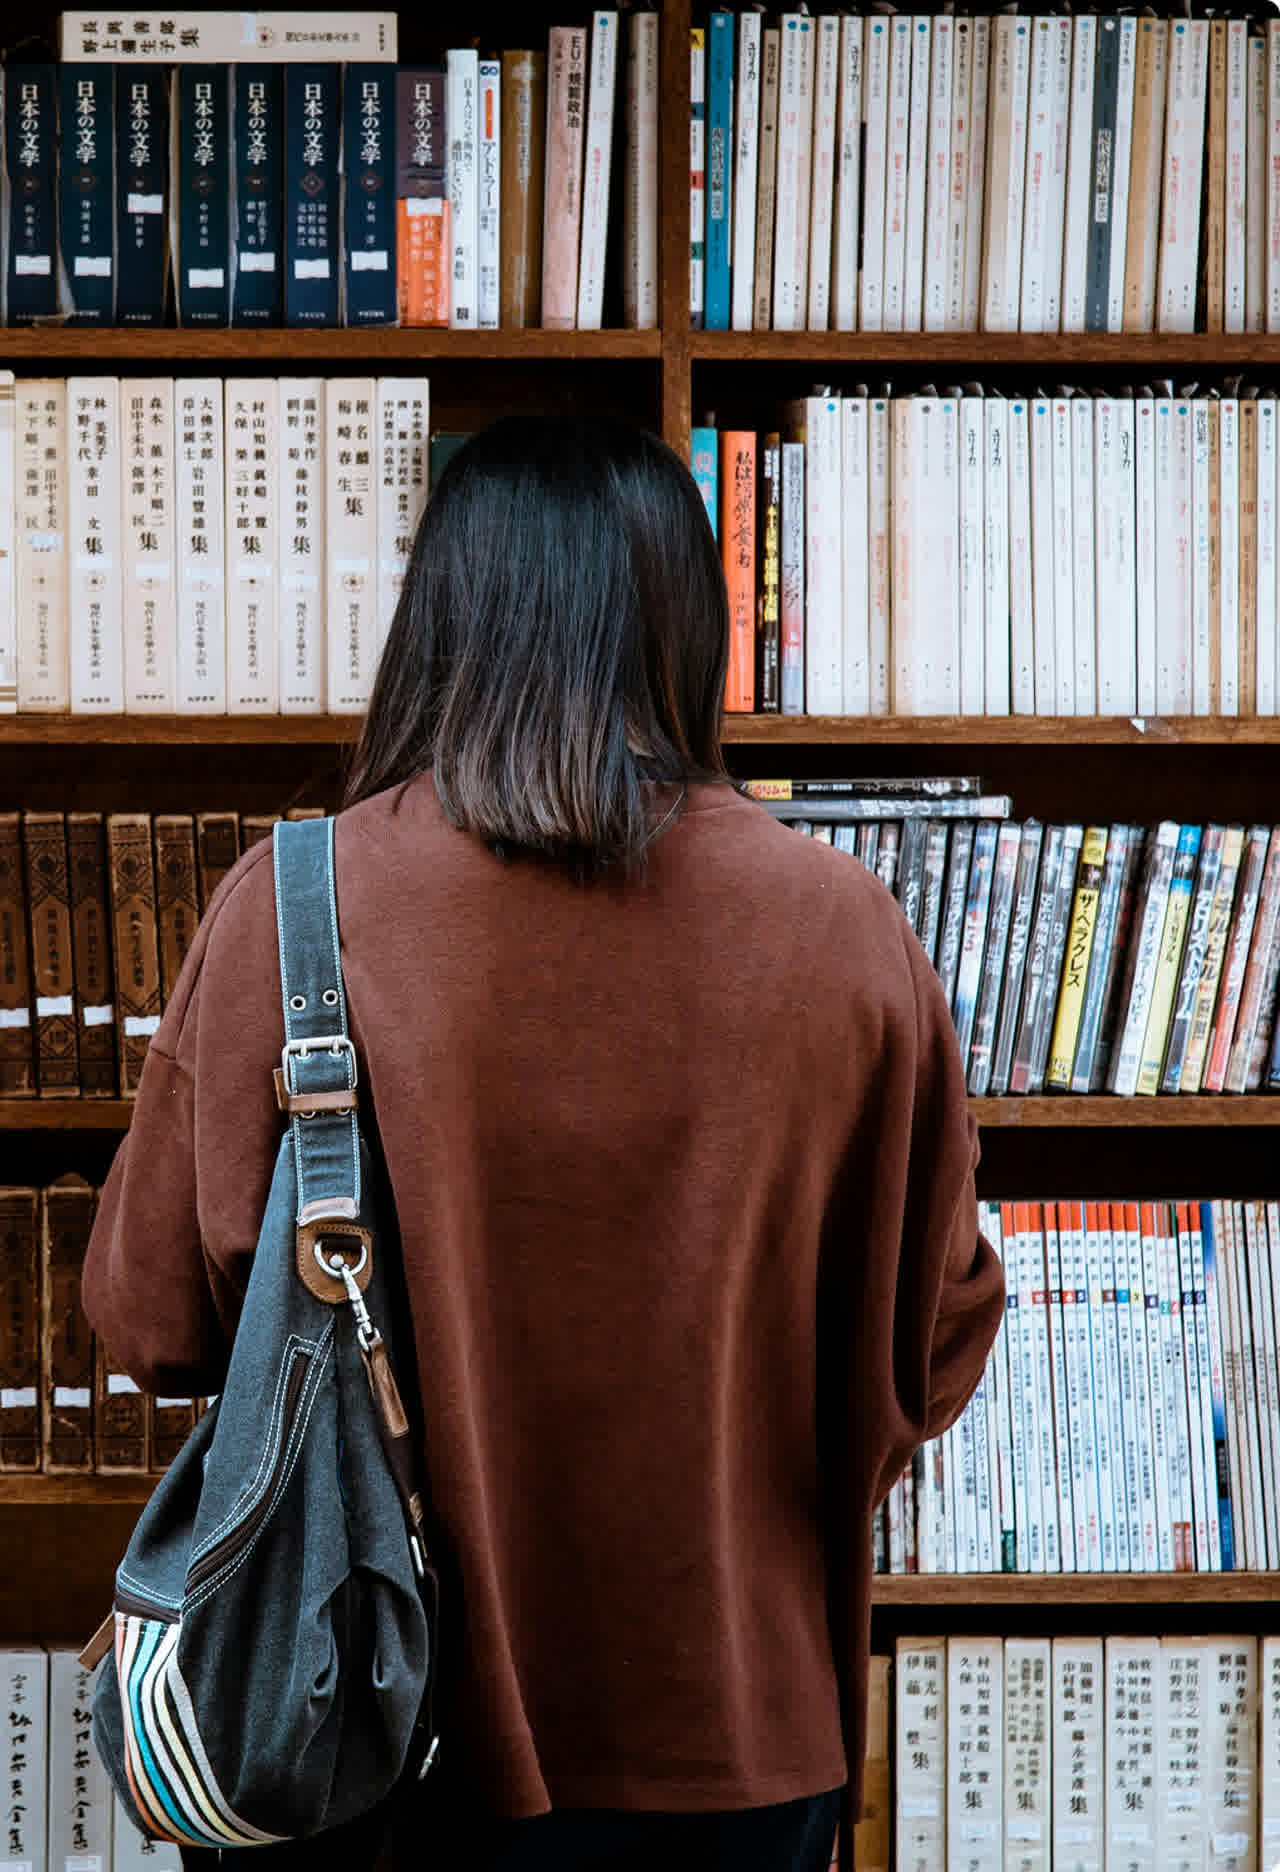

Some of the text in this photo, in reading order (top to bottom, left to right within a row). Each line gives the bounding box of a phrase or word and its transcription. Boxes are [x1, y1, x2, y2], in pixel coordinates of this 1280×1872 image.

[20, 83, 41, 168] 日本の文学
[76, 80, 97, 164] 日本の文学
[129, 83, 151, 168] 日本の文学
[193, 82, 215, 166] 日本の文学
[246, 82, 268, 166] 日本の文学
[303, 82, 325, 166] 日本の文学
[360, 81, 381, 166] 日本の文学
[413, 82, 434, 166] 日本の文学
[345, 496, 363, 518] 集
[85, 537, 104, 555] 集
[140, 532, 159, 553] 集
[191, 536, 209, 555] 集
[243, 536, 261, 555] 集
[293, 536, 311, 555] 集
[1067, 891, 1097, 990] ザ・ヘラクレス
[912, 1752, 929, 1770] 集
[964, 1791, 982, 1810] 集
[1017, 1792, 1035, 1811] 集
[1070, 1795, 1088, 1815] 集
[1125, 1792, 1144, 1812] 集
[1223, 1789, 1241, 1809] 集
